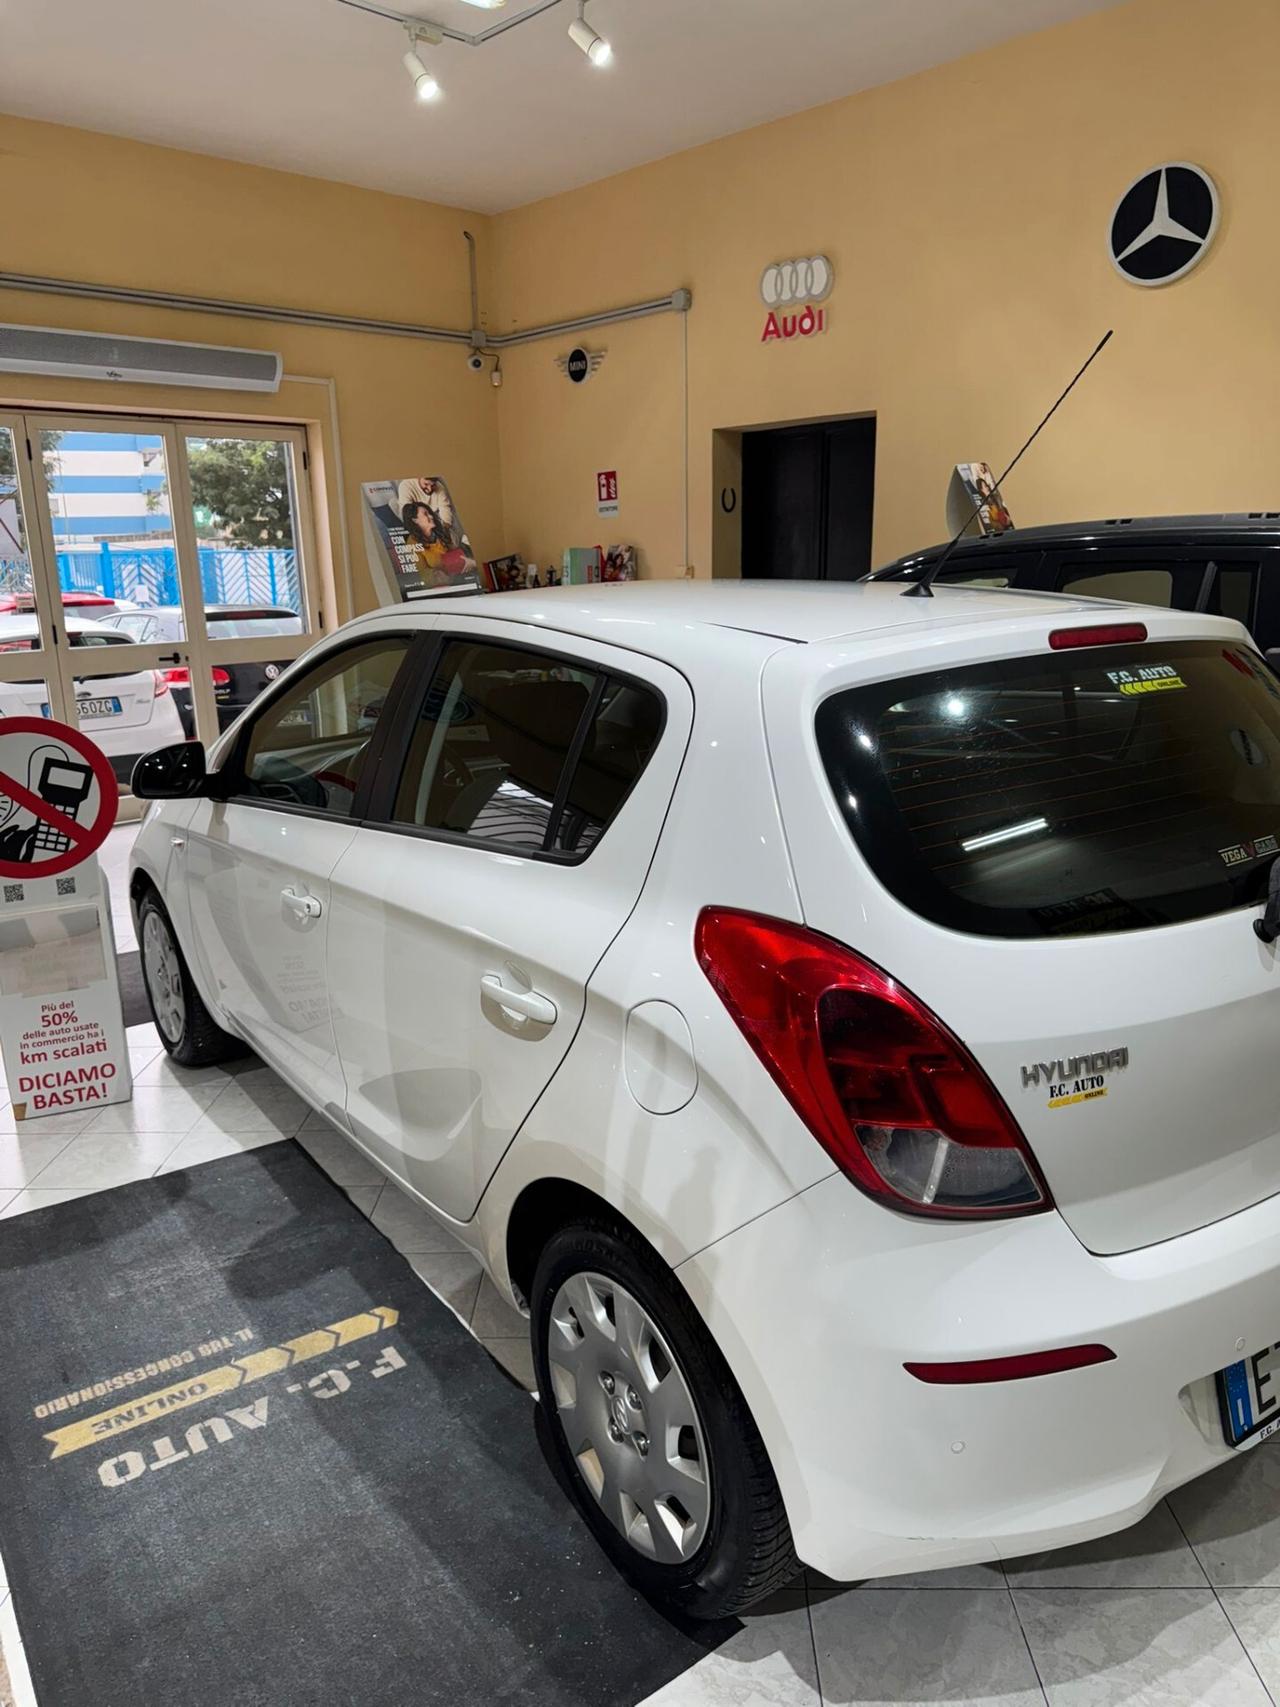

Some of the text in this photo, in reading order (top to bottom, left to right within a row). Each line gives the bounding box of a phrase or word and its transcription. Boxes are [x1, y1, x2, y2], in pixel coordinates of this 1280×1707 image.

[761, 305, 823, 342] Audi
[569, 360, 586, 371] MINI
[401, 563, 419, 574] FARE
[1107, 665, 1177, 684] F.C. AUTO
[1221, 848, 1248, 863] VEGA
[41, 1000, 74, 1012] Più del
[22, 1022, 99, 1040] delle auto usate
[41, 1010, 78, 1028] 50%
[32, 1034, 85, 1048] commercio
[87, 1031, 99, 1039] ha
[20, 1039, 108, 1065] km scalati
[19, 1063, 116, 1092] DICIAMO
[1020, 1046, 1129, 1088] HYUNDAI
[33, 1082, 107, 1110] BASTA!
[1049, 1074, 1104, 1098] F.C. AUTO
[34, 1328, 254, 1419] IL TUO CONCESSIONARIO
[90, 1382, 208, 1435] ONLINE
[97, 1396, 269, 1488] AUTO
